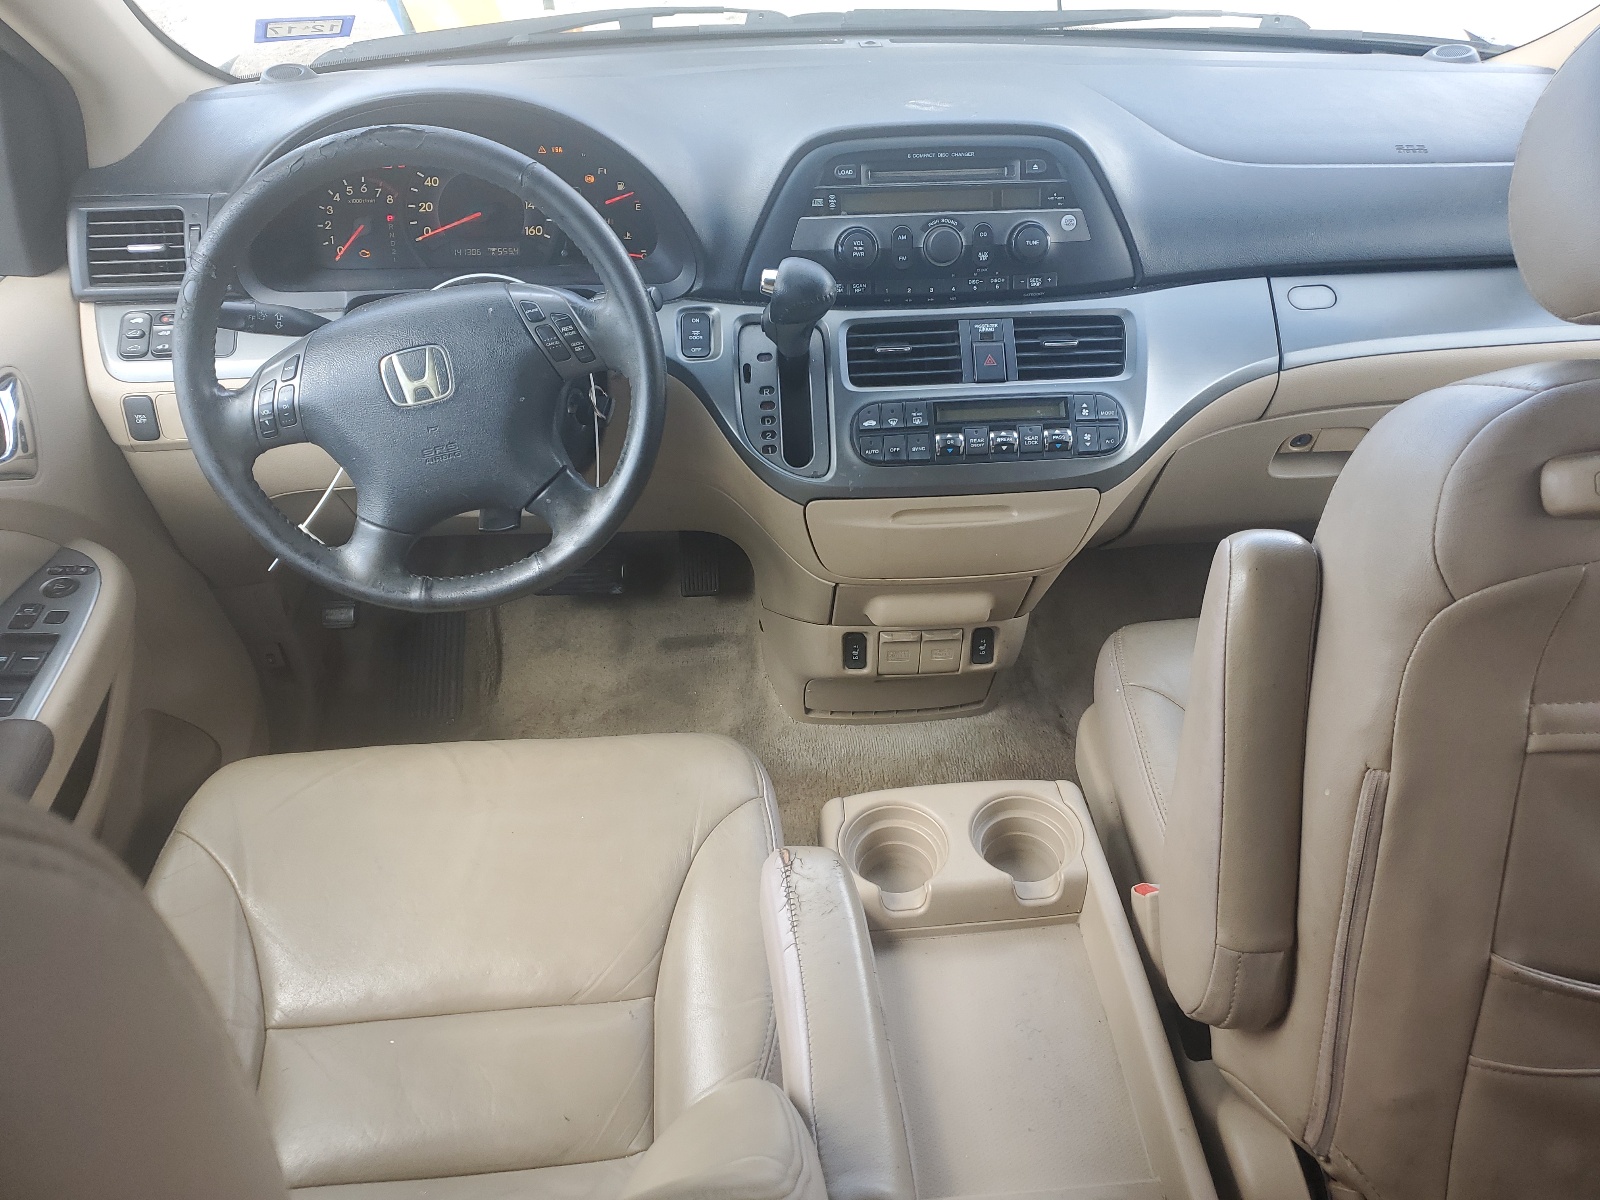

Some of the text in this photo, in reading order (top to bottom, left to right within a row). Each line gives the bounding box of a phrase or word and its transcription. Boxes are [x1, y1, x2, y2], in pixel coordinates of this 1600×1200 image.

[424, 176, 440, 187] 40
[346, 186, 354, 195] 5
[360, 183, 368, 193] 6
[374, 188, 382, 198] 7
[333, 193, 341, 202] 4
[386, 194, 394, 204] 8
[326, 205, 334, 215] 3
[418, 202, 433, 212] 20
[635, 203, 642, 211] E
[324, 220, 332, 230] 2
[524, 225, 543, 236] 160
[330, 235, 335, 245] 1
[762, 388, 771, 396] R
[764, 417, 772, 425] D
